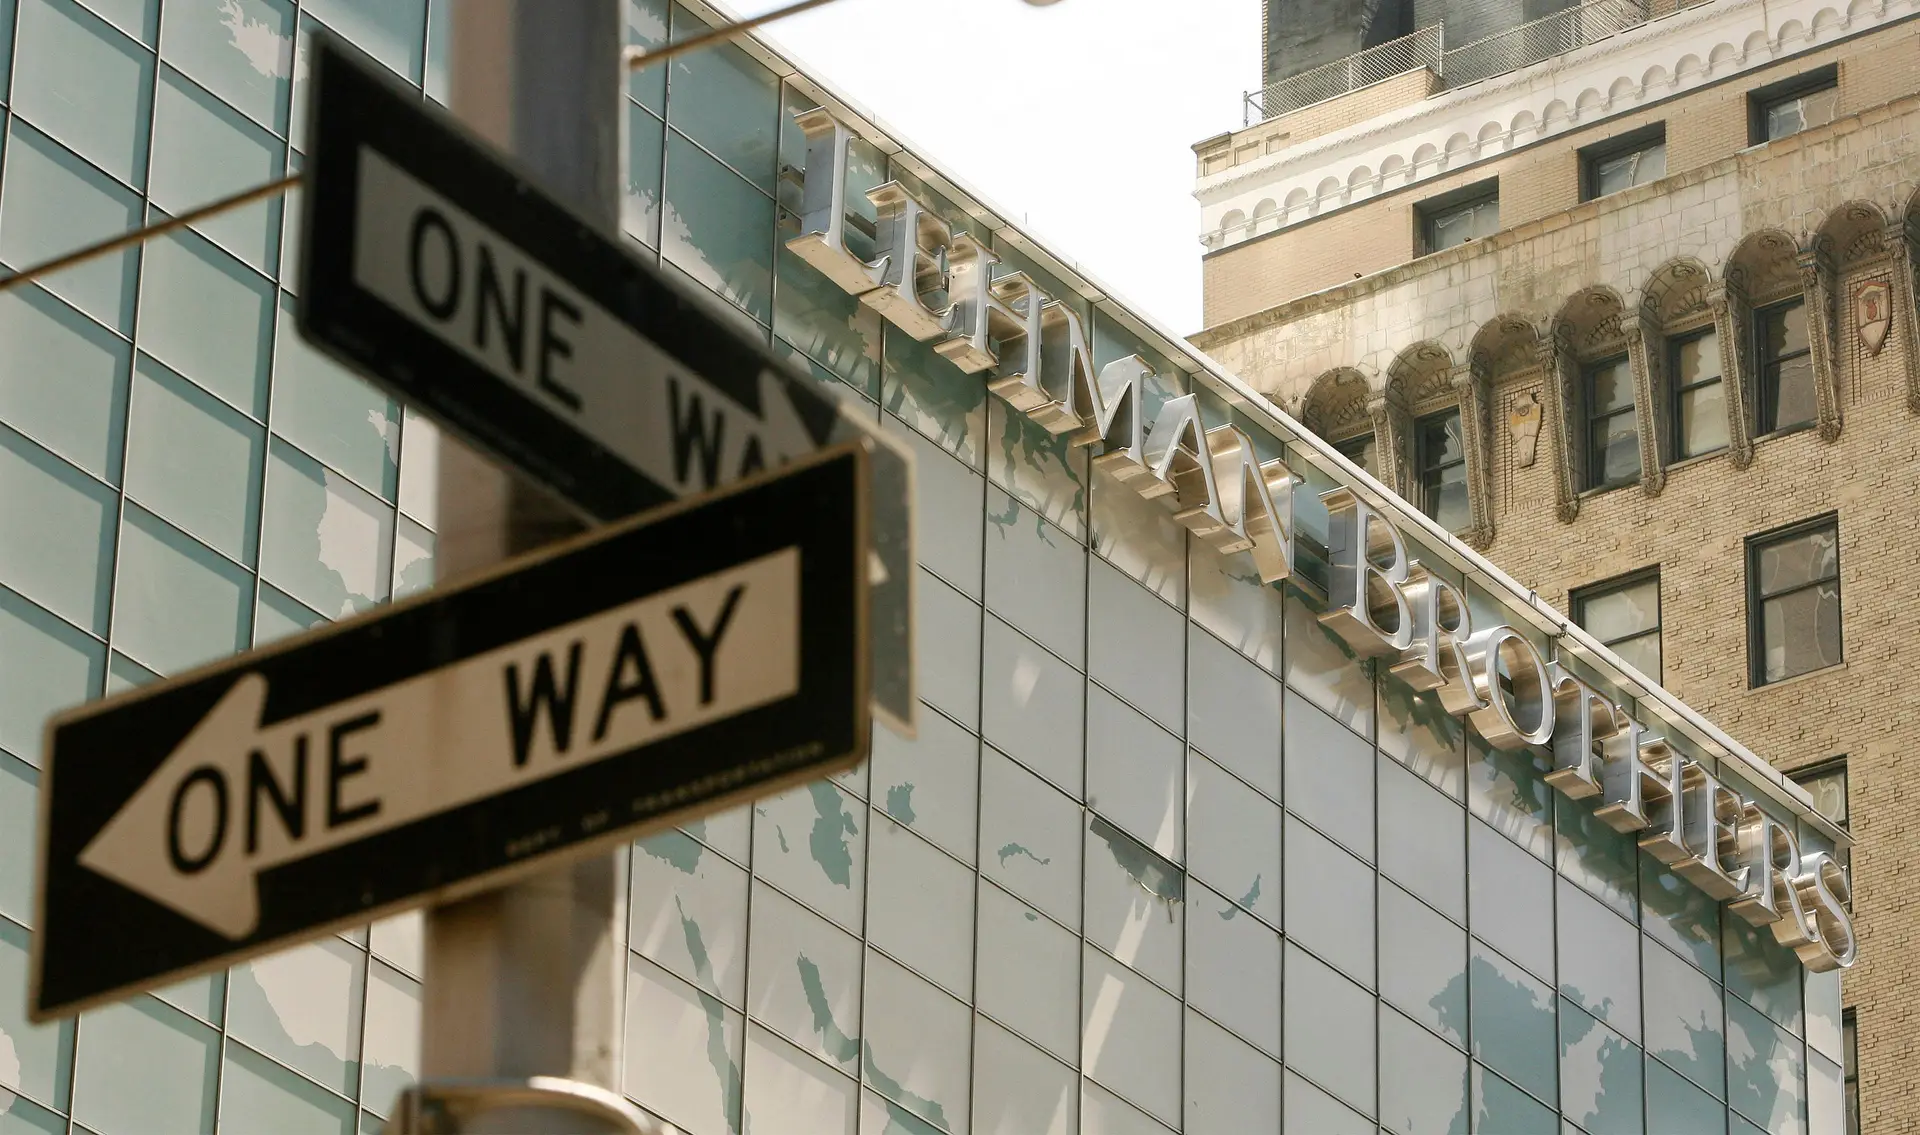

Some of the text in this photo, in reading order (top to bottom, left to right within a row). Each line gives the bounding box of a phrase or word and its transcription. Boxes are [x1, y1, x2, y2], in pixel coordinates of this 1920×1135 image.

[409, 205, 584, 414] ONE
[665, 371, 791, 492] WA
[785, 106, 1857, 972] LEHMAN BROTHERS
[165, 709, 382, 876] ONE
[502, 583, 748, 769] WAY
